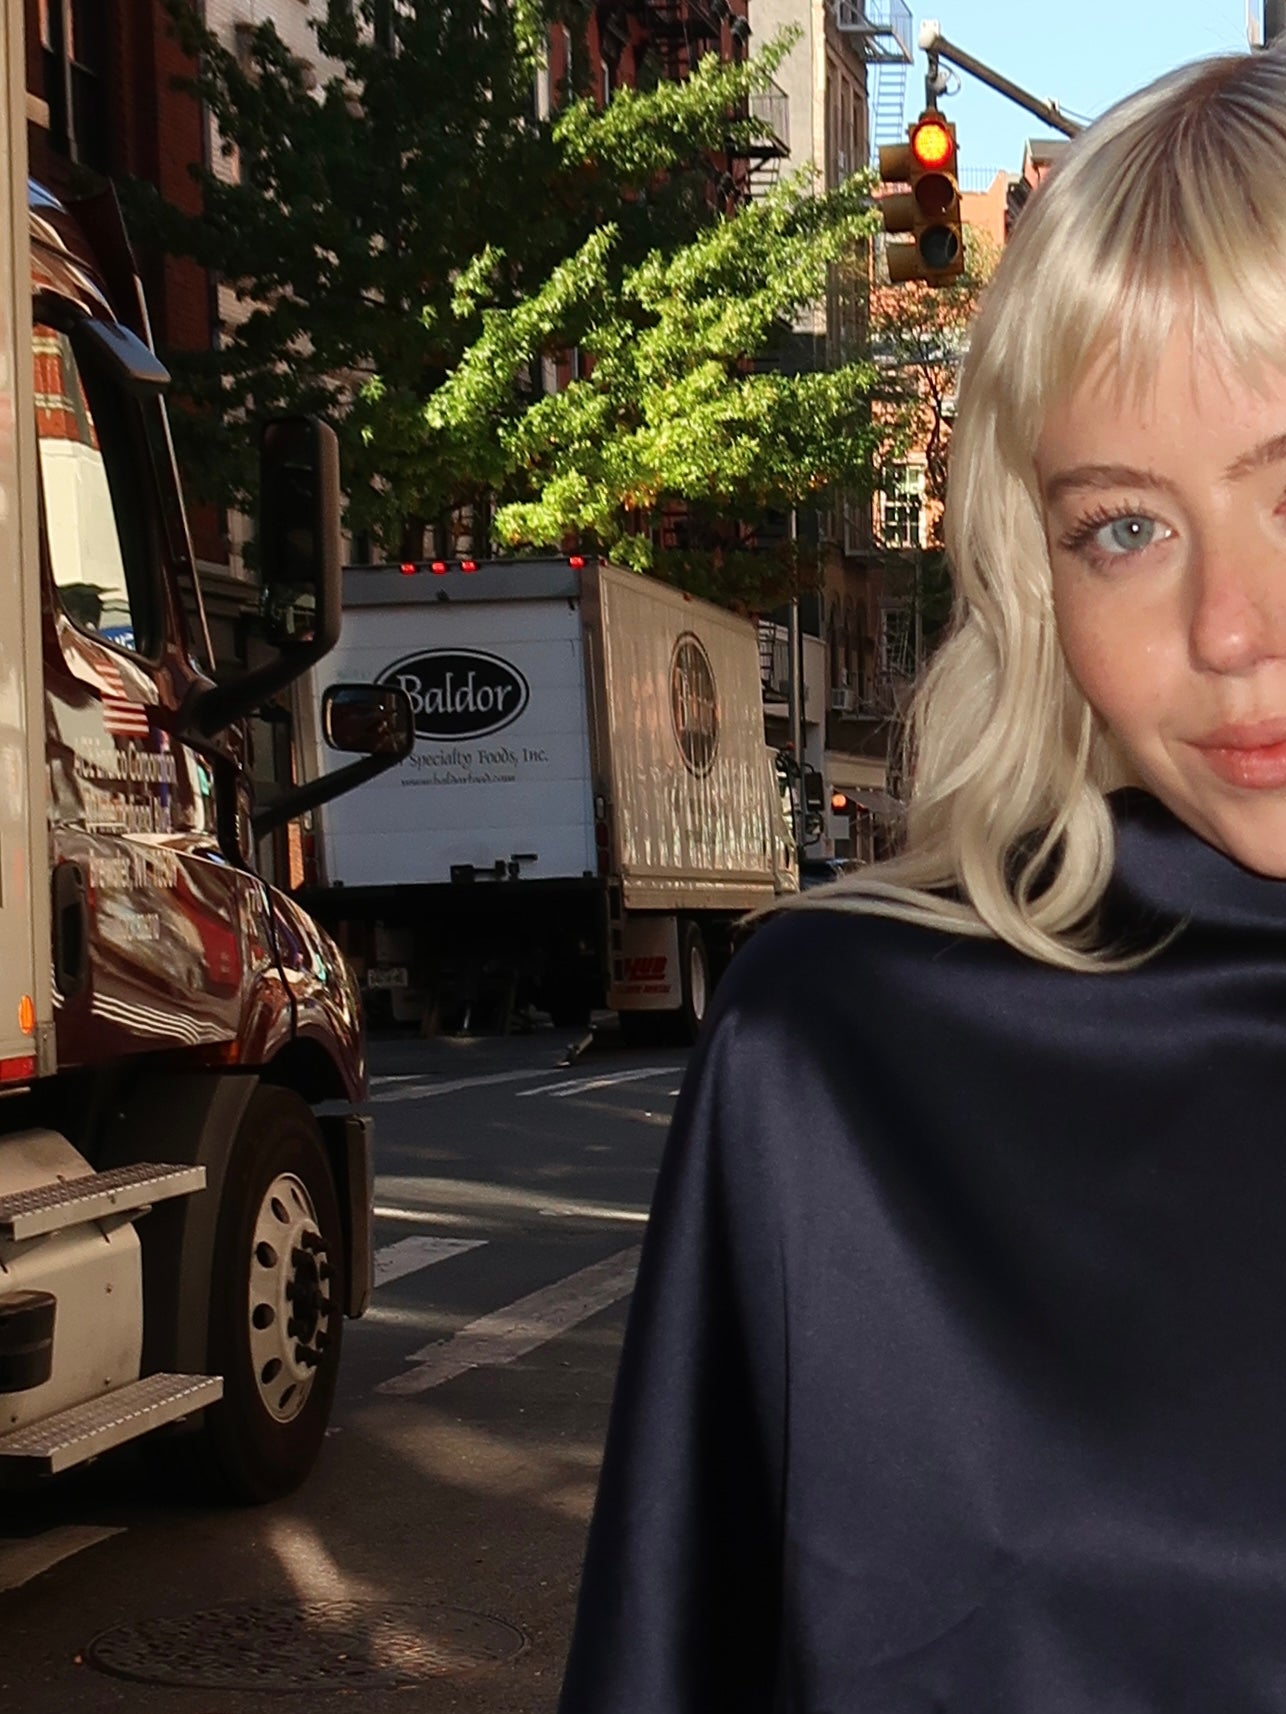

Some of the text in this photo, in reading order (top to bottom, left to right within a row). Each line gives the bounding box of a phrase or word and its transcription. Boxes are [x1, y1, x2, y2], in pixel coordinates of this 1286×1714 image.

[396, 671, 512, 714] Baldor
[410, 748, 549, 770] Specialty Foods, Inc.
